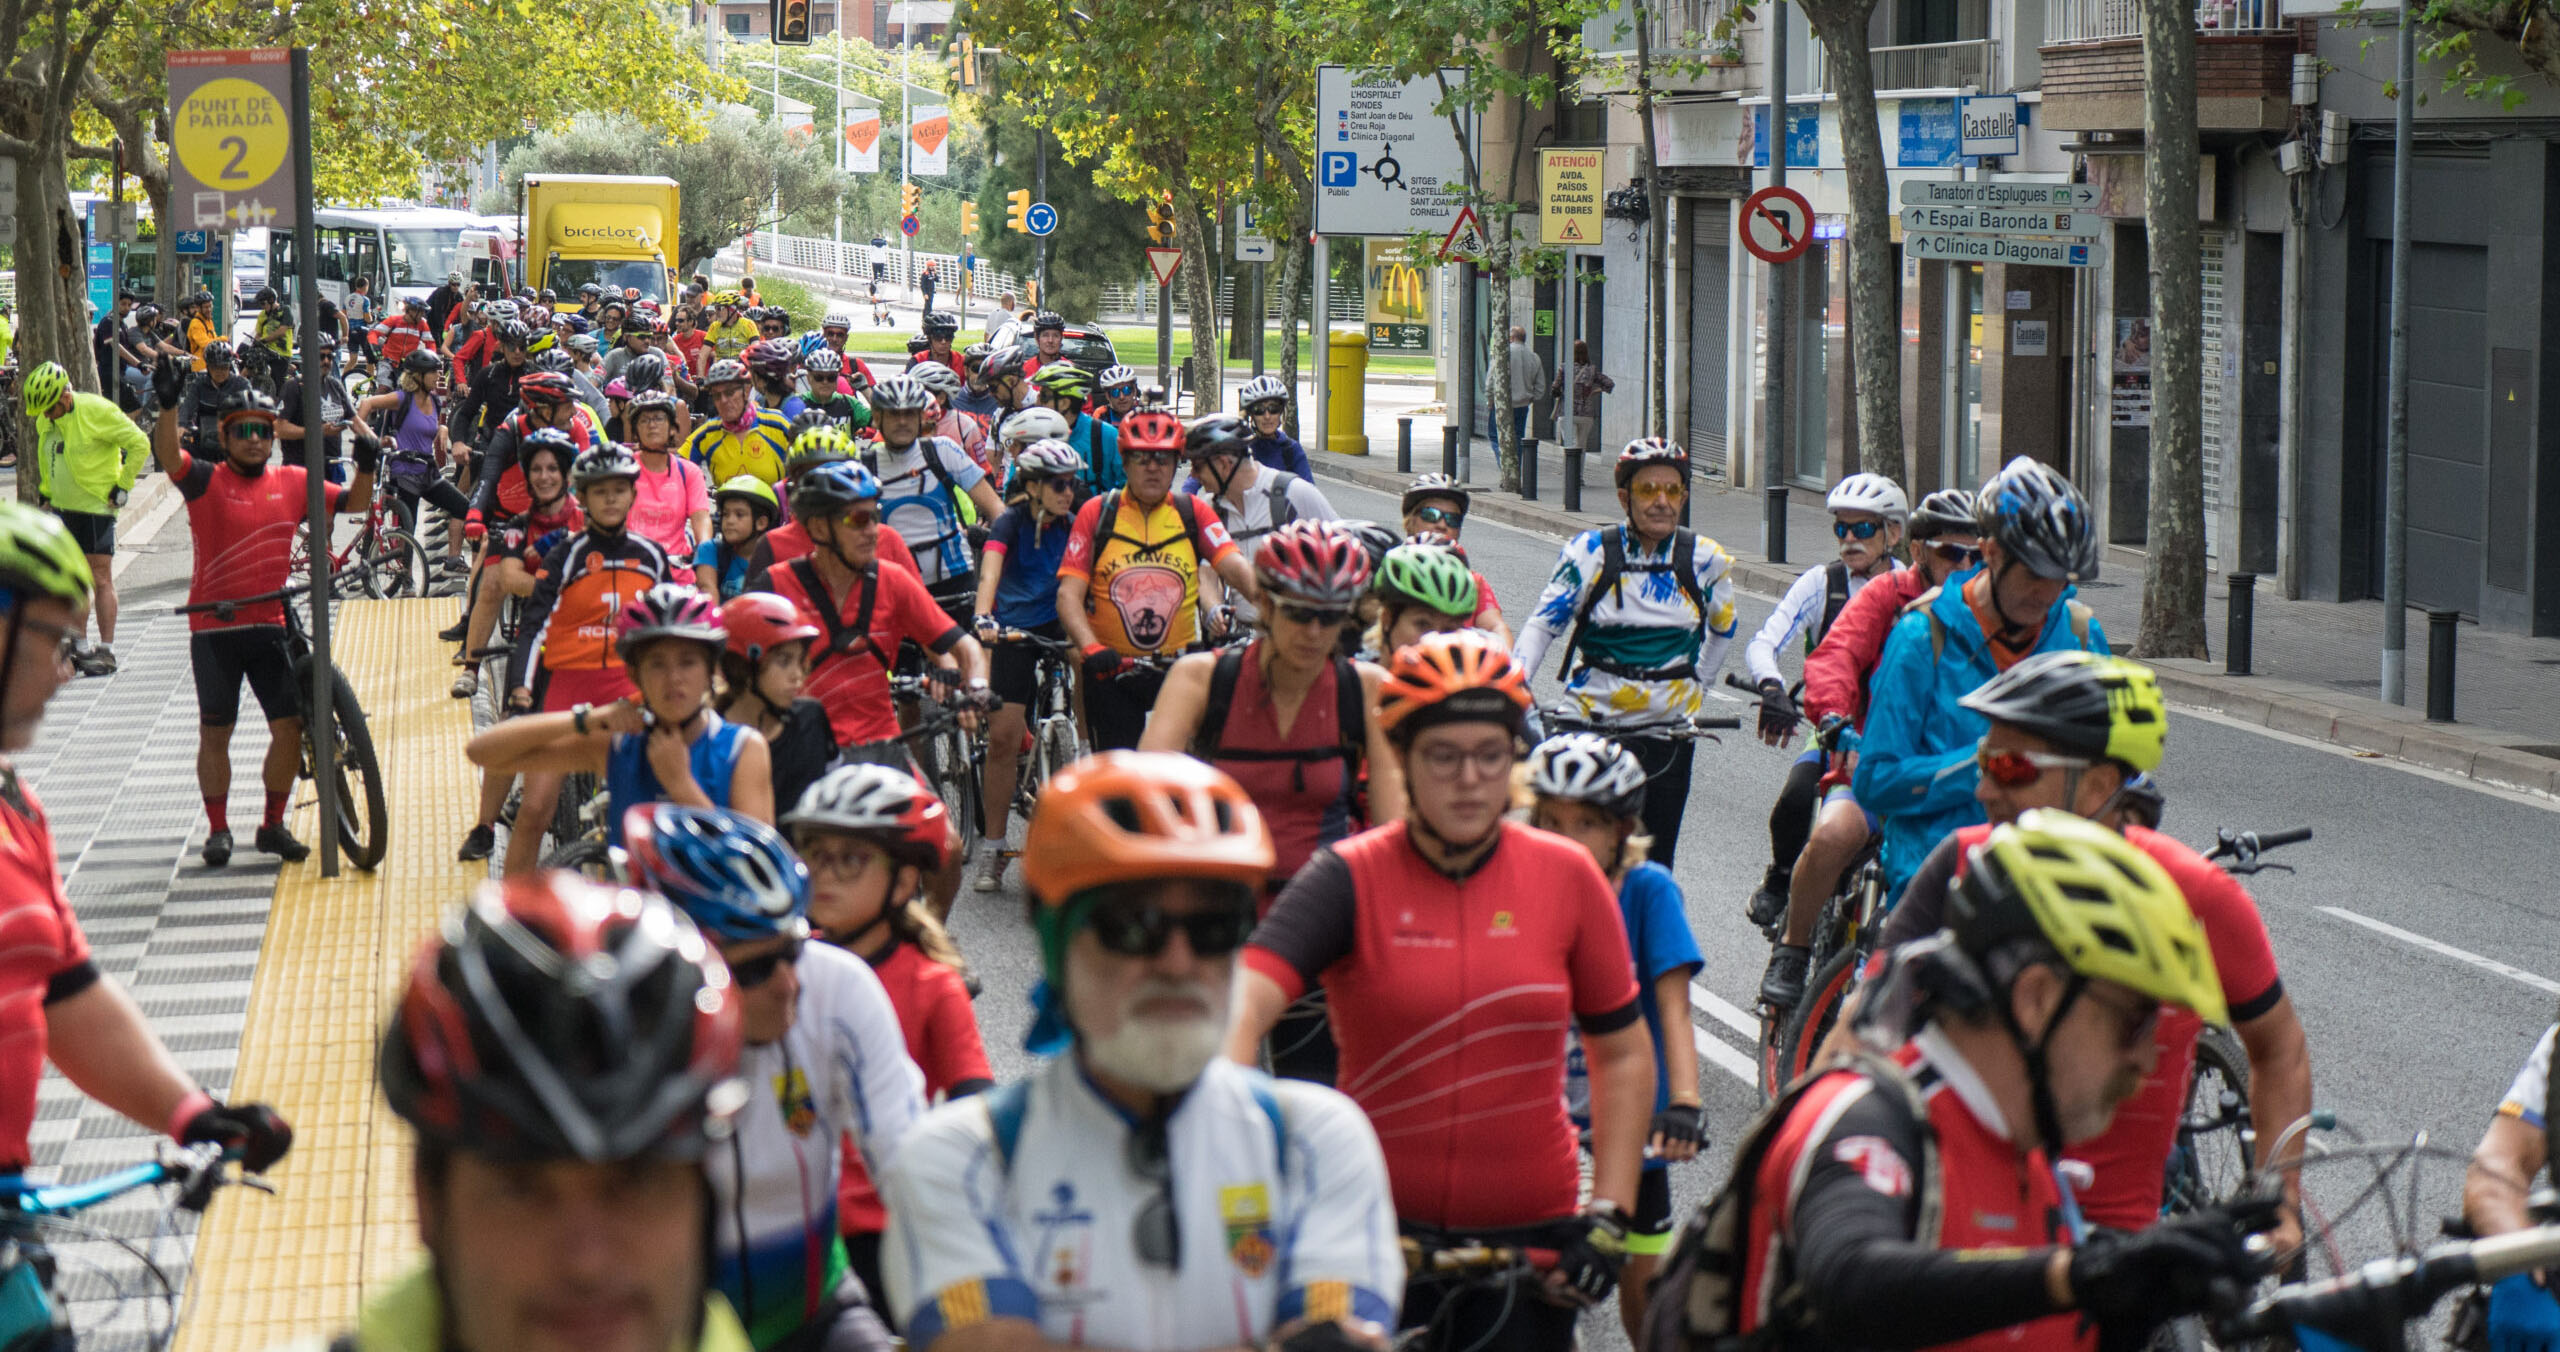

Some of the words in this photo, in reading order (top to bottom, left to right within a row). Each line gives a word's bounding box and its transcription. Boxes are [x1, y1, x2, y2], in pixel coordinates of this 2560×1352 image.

[1351, 90, 1402, 99] L'HOSPITALET
[188, 99, 239, 112] PUNT
[248, 97, 273, 111] DE
[1350, 101, 1383, 109] RONDES
[189, 112, 273, 128] PARADA
[1350, 111, 1367, 120] Sant
[1369, 111, 1386, 120] Joan
[1387, 112, 1397, 120] de
[1398, 111, 1413, 120] Déu
[1350, 121, 1368, 130] Creu
[1369, 121, 1386, 132] Roja
[1963, 112, 2015, 138] Castellà
[1380, 132, 1415, 142] Diagonal
[219, 135, 249, 180] 2
[1549, 154, 1597, 168] ATENCIÓ
[1410, 176, 1437, 185] SITGES
[1560, 171, 1585, 179] AVDA.
[1551, 194, 1594, 203] CATALANS
[1928, 184, 1974, 201] Tanatori
[1977, 185, 2047, 205] d'Esplugues
[1410, 197, 1430, 206] SANT
[1551, 206, 1562, 215] EN
[1565, 206, 1593, 215] OBRES
[1929, 210, 1974, 230] Espai
[1980, 212, 2048, 230] Baronda
[564, 226, 636, 238] biciclot
[1934, 237, 1988, 256] Clínica
[1994, 240, 2064, 262] Diagonal
[1376, 326, 1390, 338] 24
